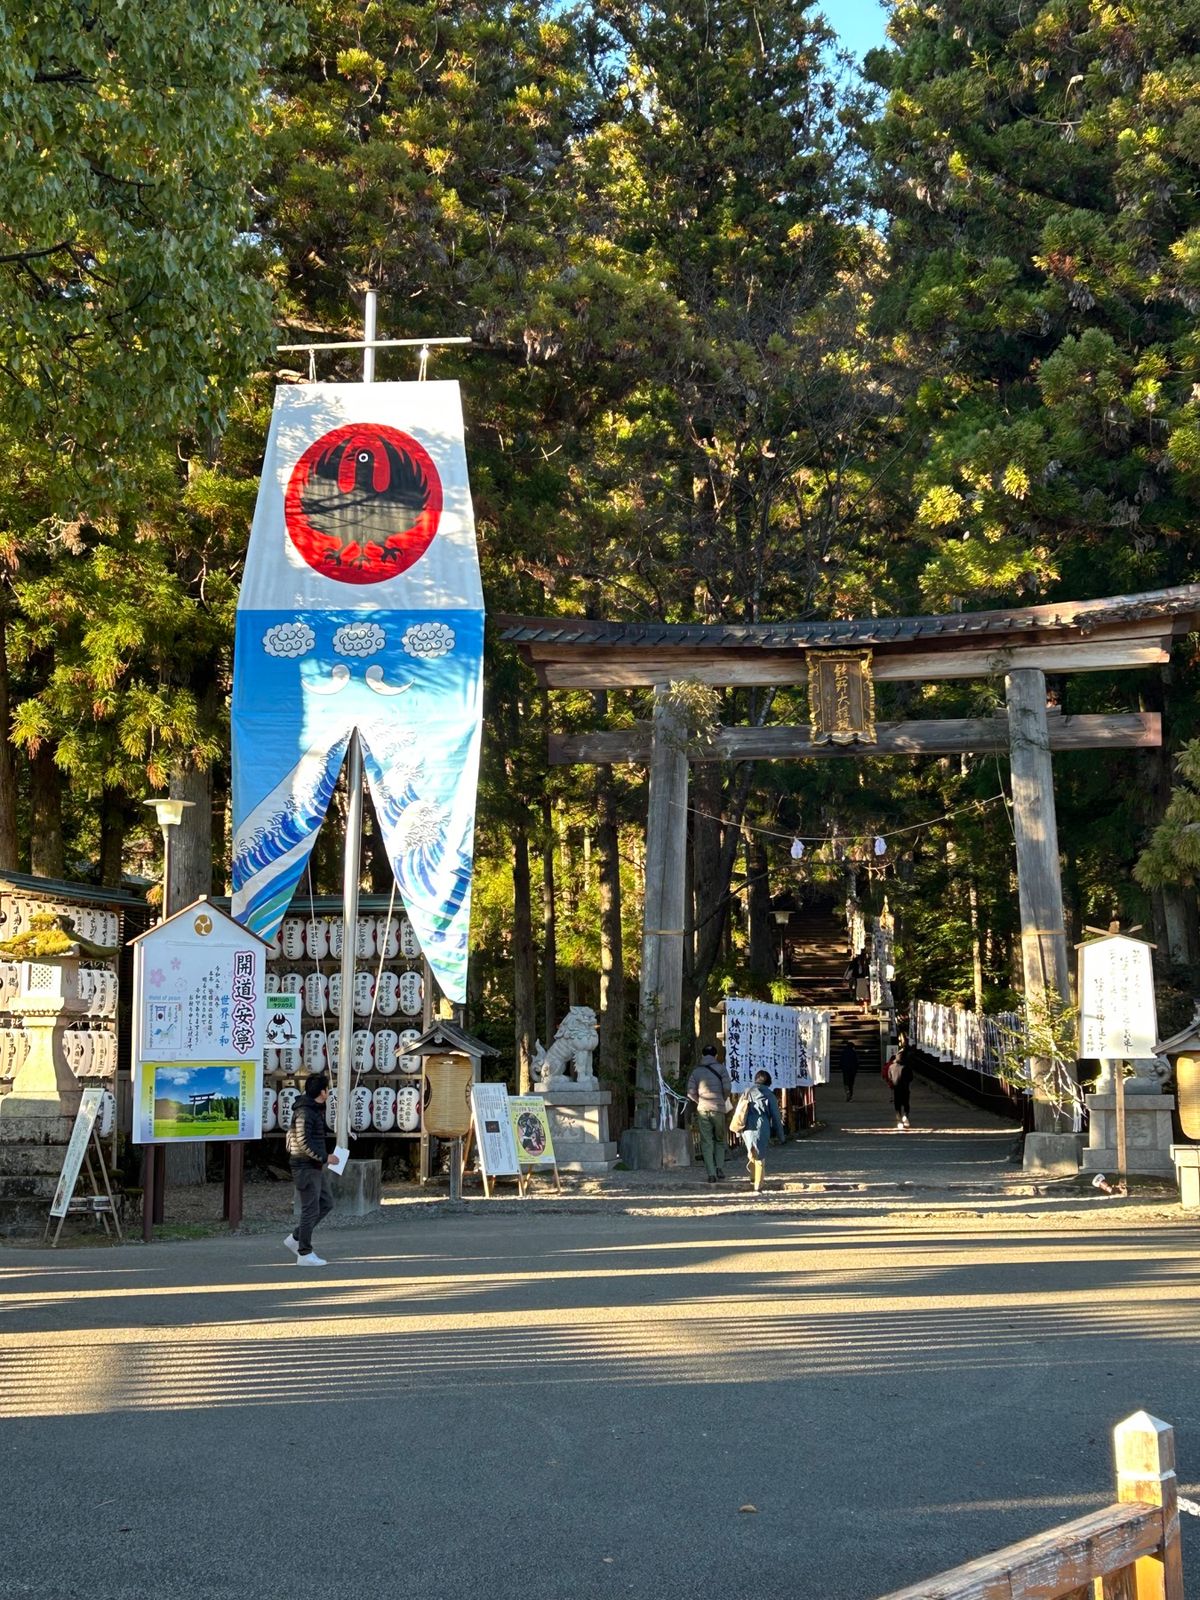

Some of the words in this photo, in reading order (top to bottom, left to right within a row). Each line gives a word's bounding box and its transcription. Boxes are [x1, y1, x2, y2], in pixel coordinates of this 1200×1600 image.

[219, 995, 230, 1046] 世界平和
[234, 953, 255, 1052] 開道安寧
